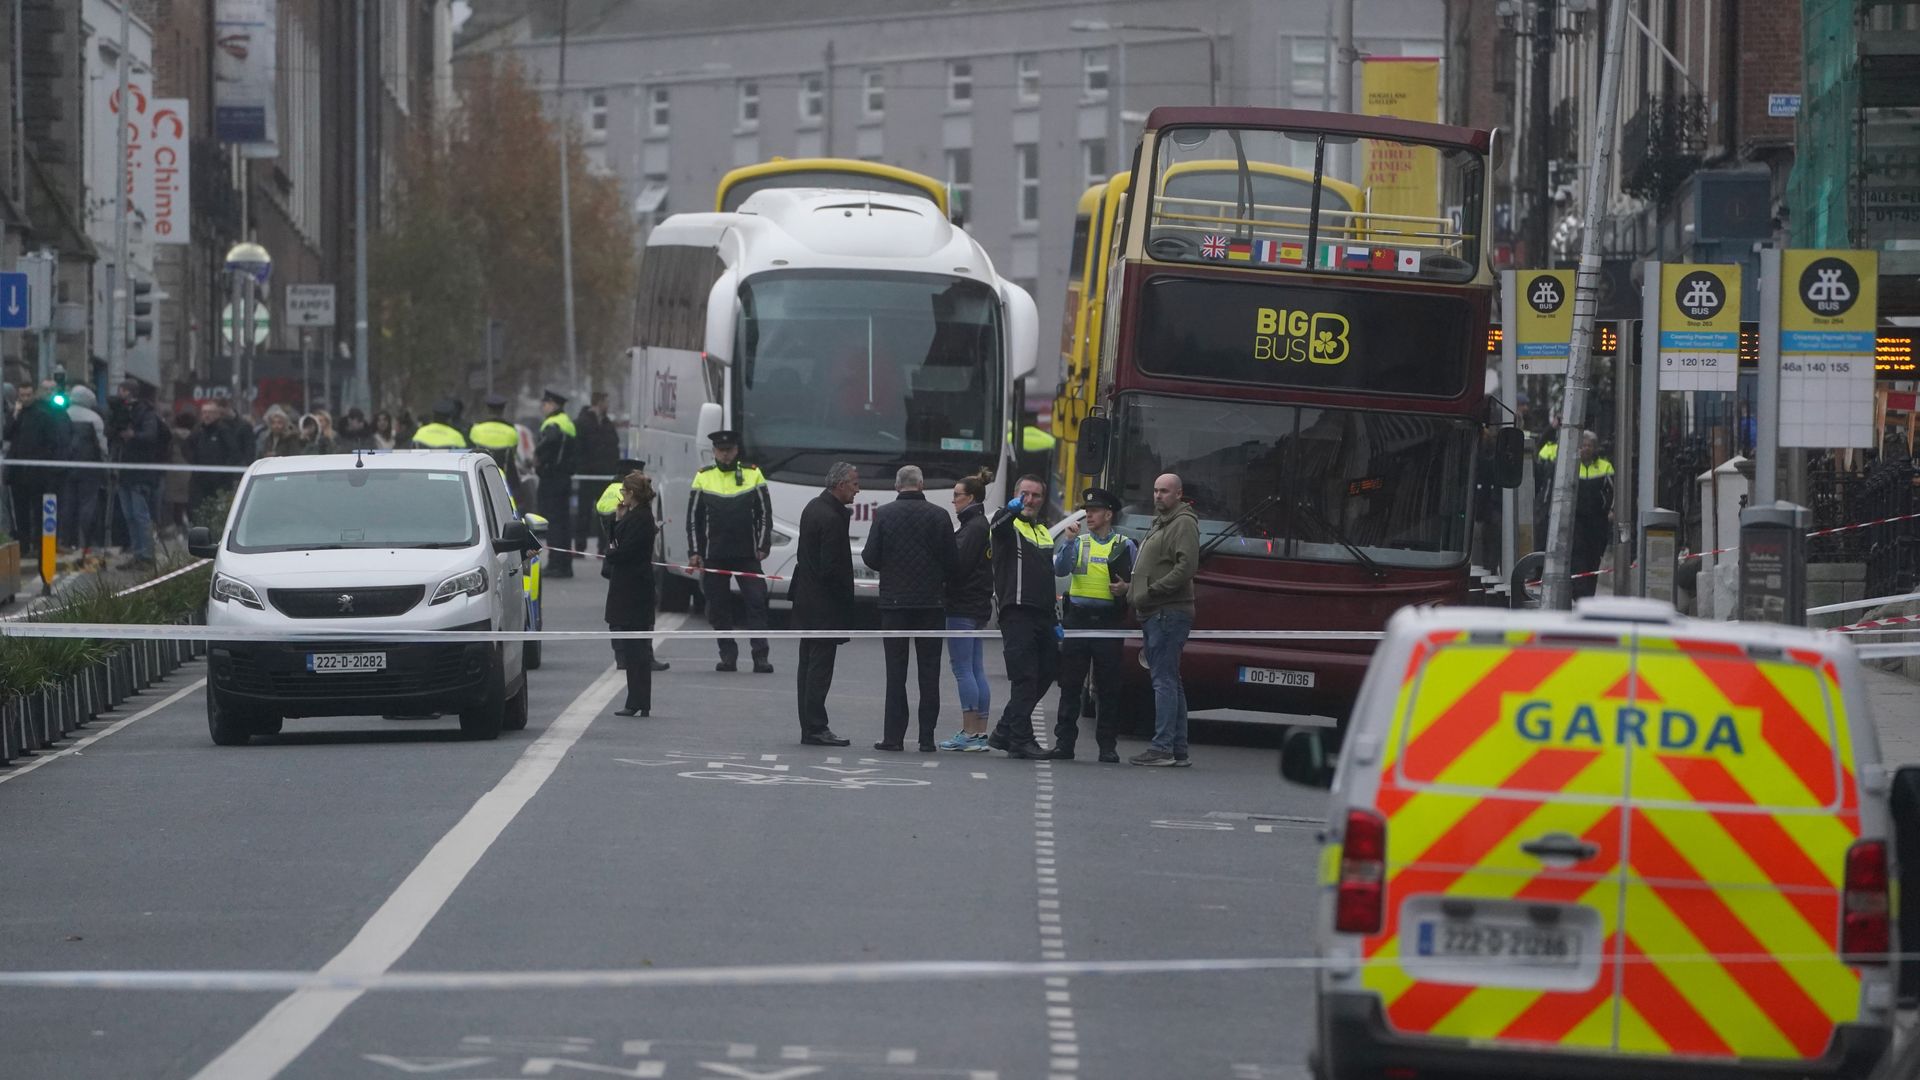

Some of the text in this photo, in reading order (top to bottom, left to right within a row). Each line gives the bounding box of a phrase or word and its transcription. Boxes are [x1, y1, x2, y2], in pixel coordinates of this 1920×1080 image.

[1369, 173, 1397, 184] OUT
[154, 147, 179, 236] Chime
[1691, 307, 1709, 315] BUS
[1818, 301, 1840, 311] BUS
[1256, 307, 1309, 337] BIG
[1254, 335, 1307, 363] BUS
[1666, 358, 1673, 366] 9
[1700, 359, 1717, 367] 122
[1781, 362, 1803, 372] 46a
[1806, 363, 1826, 372] 140
[1830, 363, 1850, 372] 155
[316, 655, 383, 668] 222-D-21282
[1250, 670, 1309, 686] 00-D-70136
[1515, 700, 1744, 756] GARDA
